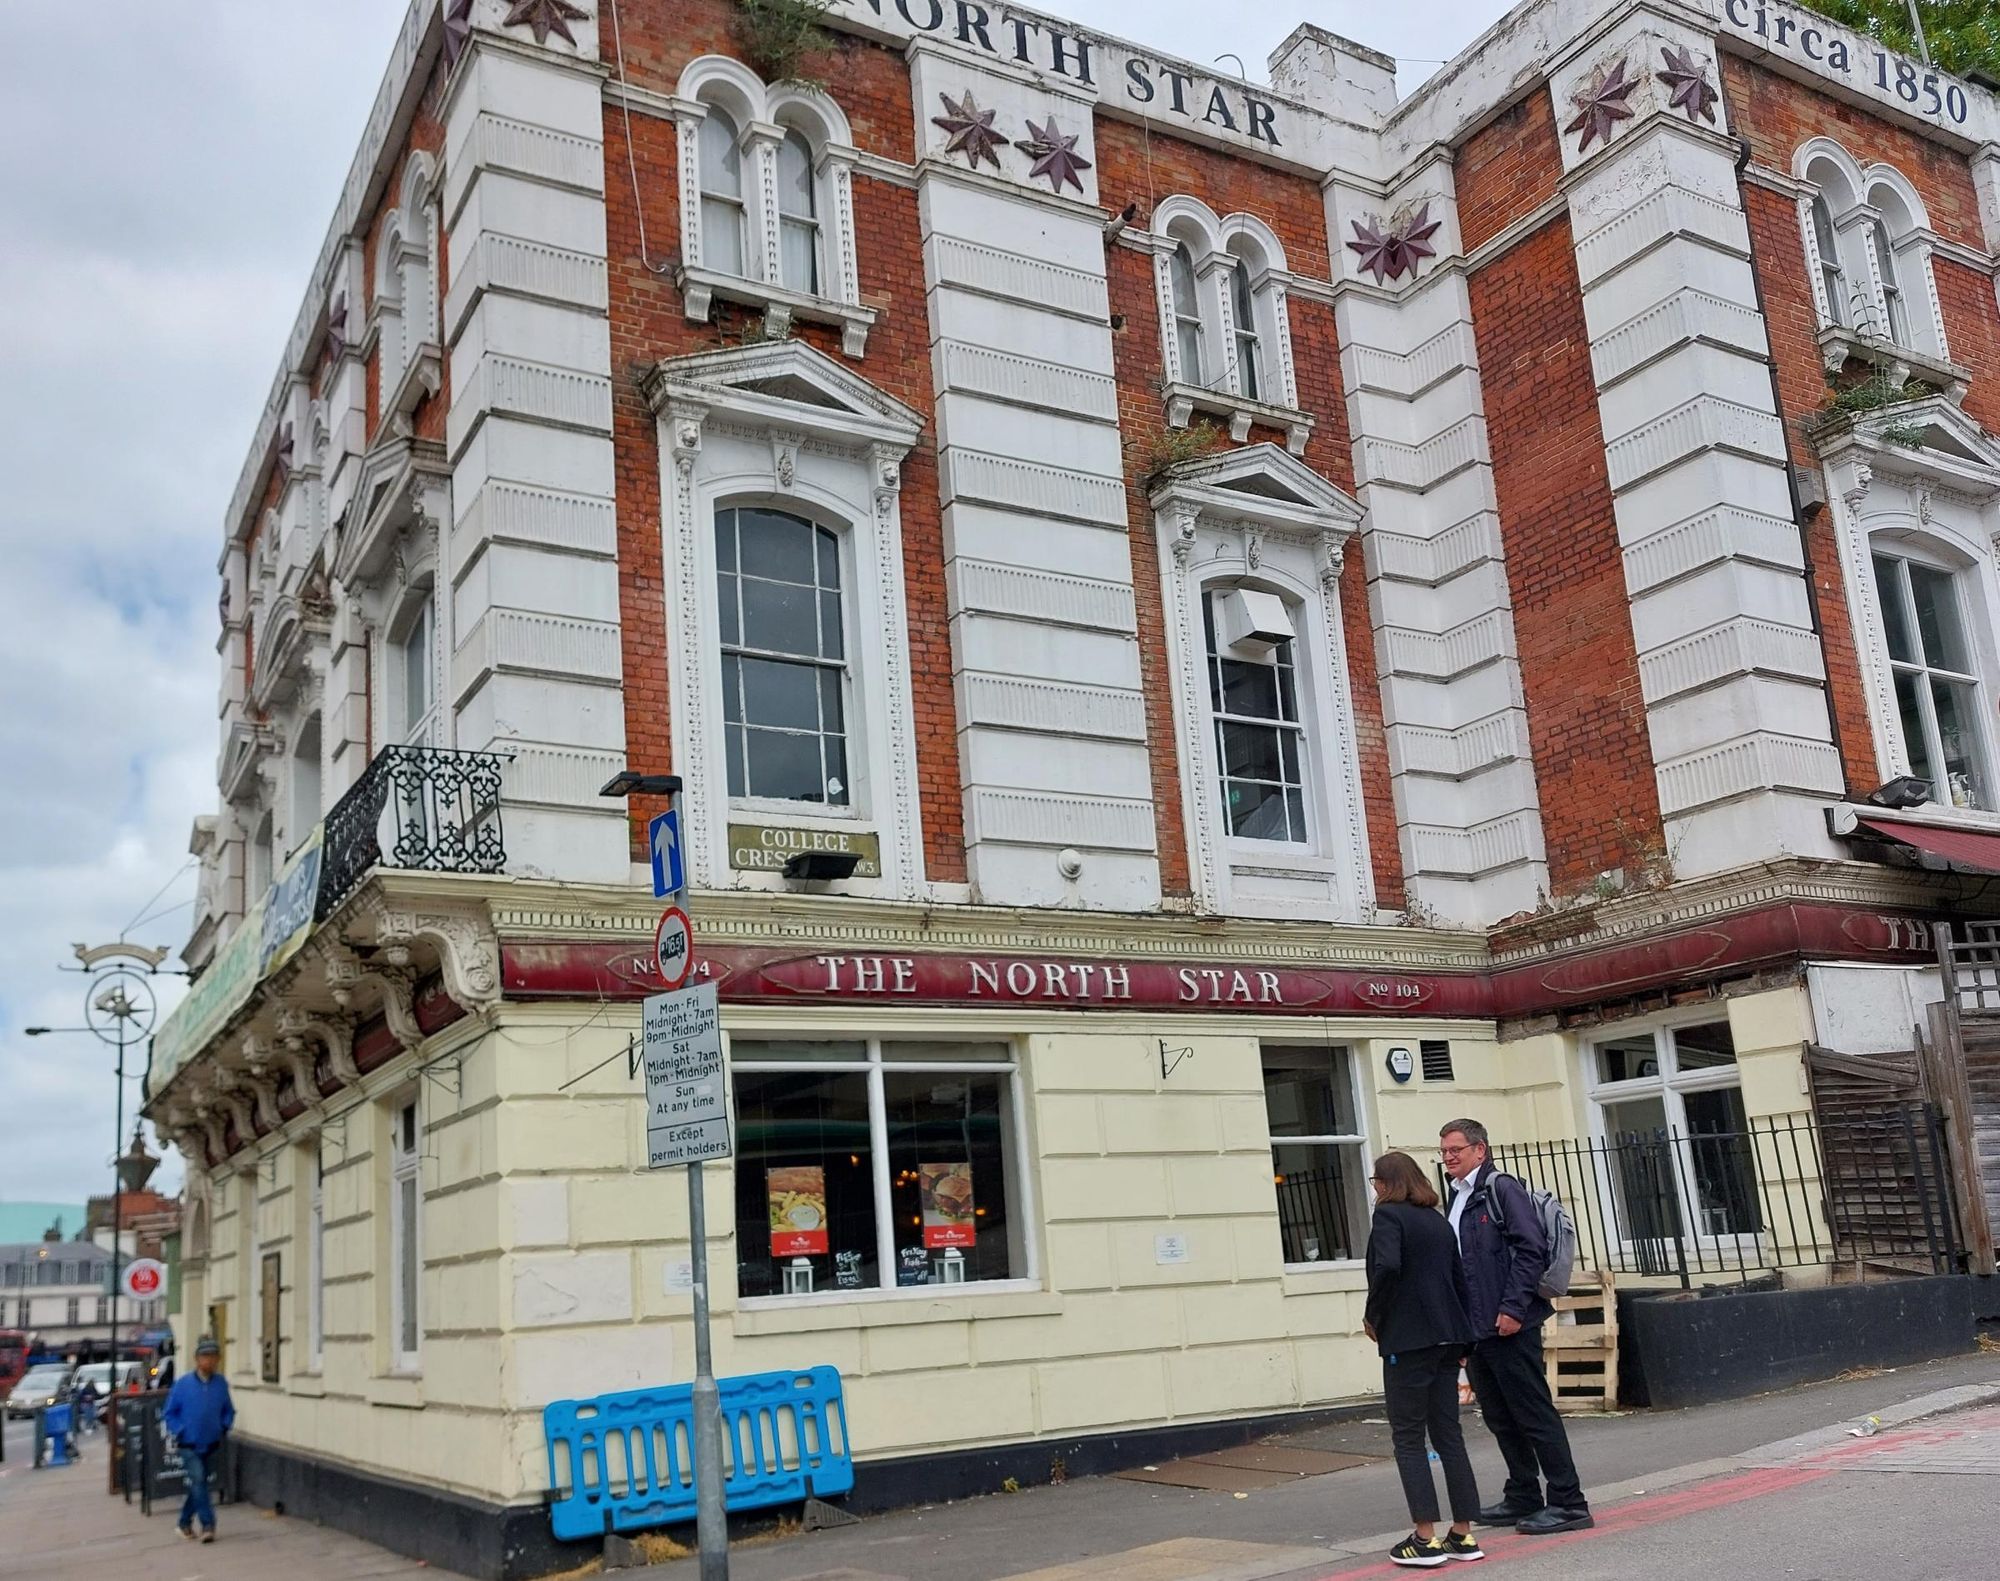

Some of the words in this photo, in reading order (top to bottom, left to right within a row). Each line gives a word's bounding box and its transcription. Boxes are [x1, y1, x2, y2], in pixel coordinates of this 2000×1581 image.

[1724, 0, 1851, 73] circa
[1873, 52, 1968, 124] 1850
[845, 0, 1096, 85] ORTH
[1125, 58, 1283, 147] STAR
[760, 829, 850, 852] COLLEGE
[1877, 915, 1935, 951] TH
[817, 955, 917, 993] THE
[967, 961, 1133, 999] NORTH
[1178, 967, 1283, 1003] STAR
[1395, 984, 1421, 998] 104
[672, 1041, 690, 1054] Sat
[675, 1086, 695, 1097] Sun
[656, 1104, 668, 1114] At
[671, 1101, 689, 1112] any
[692, 1096, 715, 1108] time
[669, 1127, 704, 1142] Except
[651, 1146, 683, 1163] permit
[687, 1142, 727, 1156] holders
